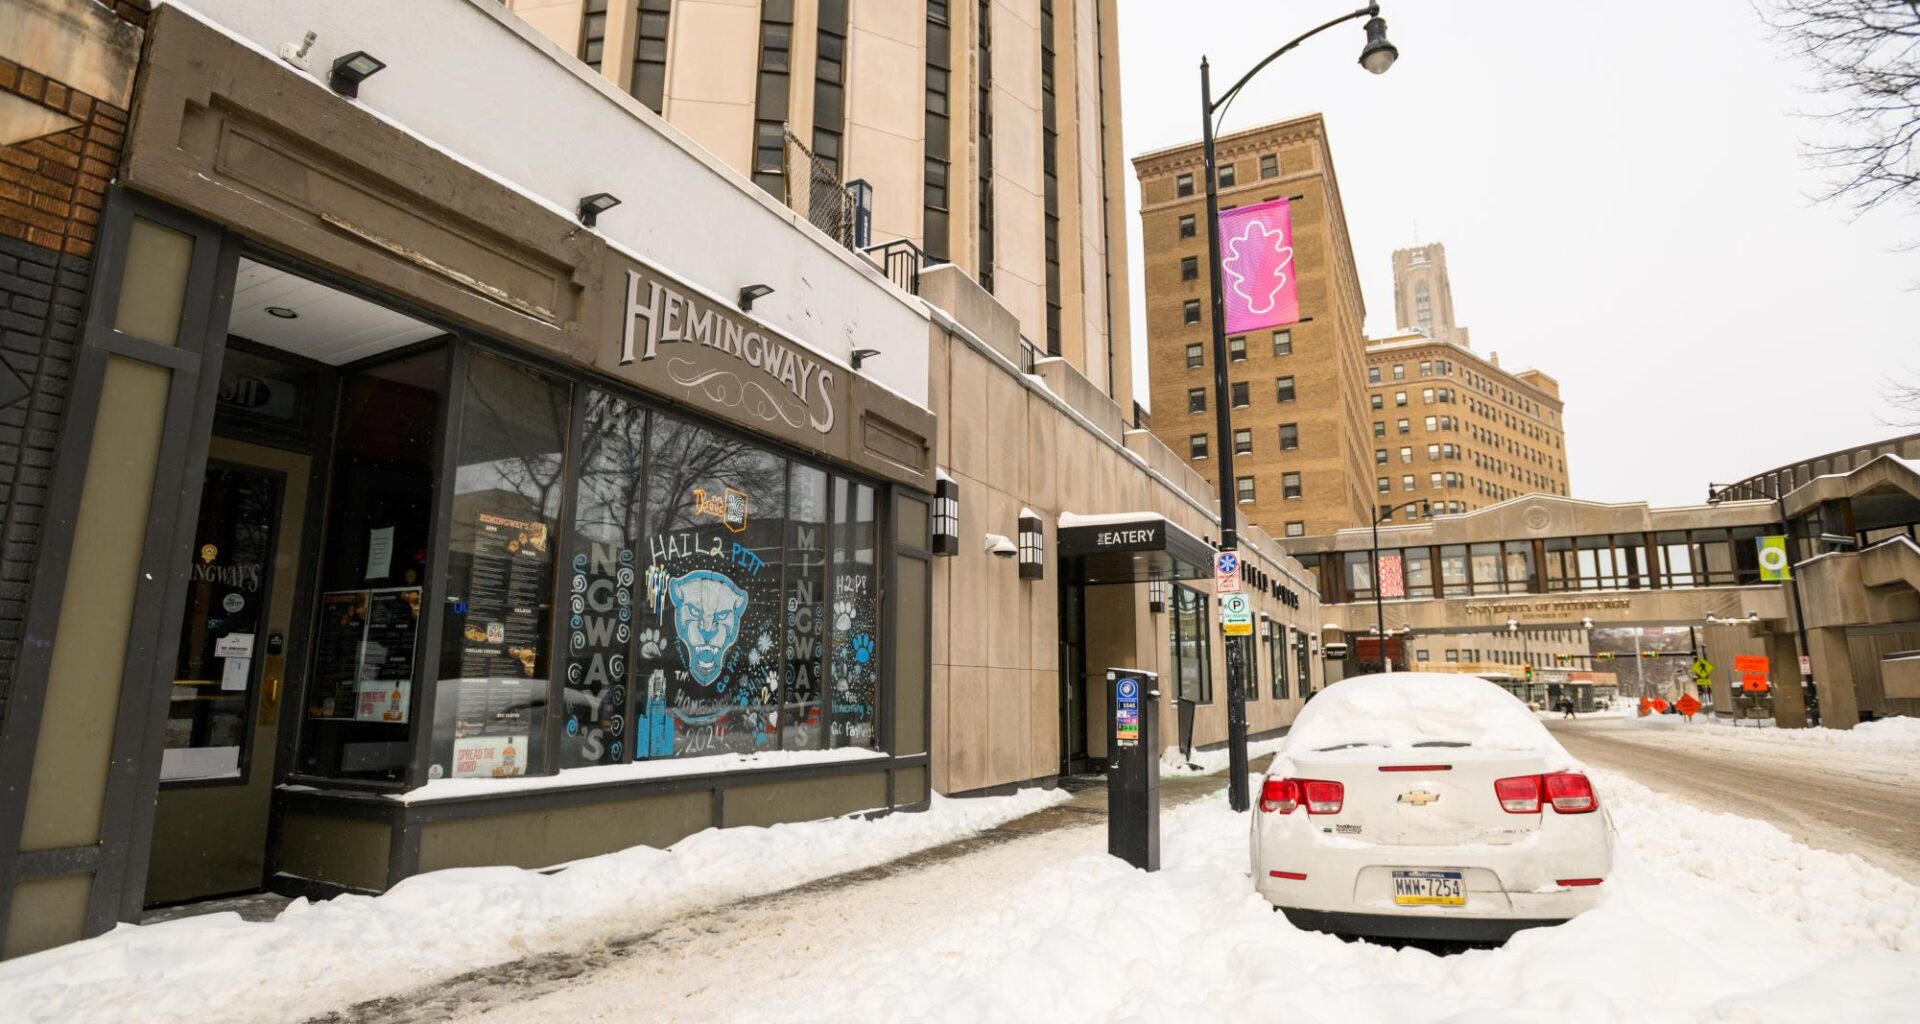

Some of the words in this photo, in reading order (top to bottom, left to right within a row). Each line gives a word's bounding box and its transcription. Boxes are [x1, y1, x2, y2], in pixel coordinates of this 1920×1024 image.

[619, 268, 835, 434] HEMINGWAY'S
[1104, 528, 1155, 545] EATERY
[649, 532, 709, 567] HAIL
[710, 536, 724, 559] 2
[1232, 600, 1241, 611] P
[1464, 604, 1531, 616] UNIVERSITY
[1535, 602, 1550, 613] OF
[1553, 600, 1631, 611] PITTSBURGH
[686, 724, 726, 752] 2024
